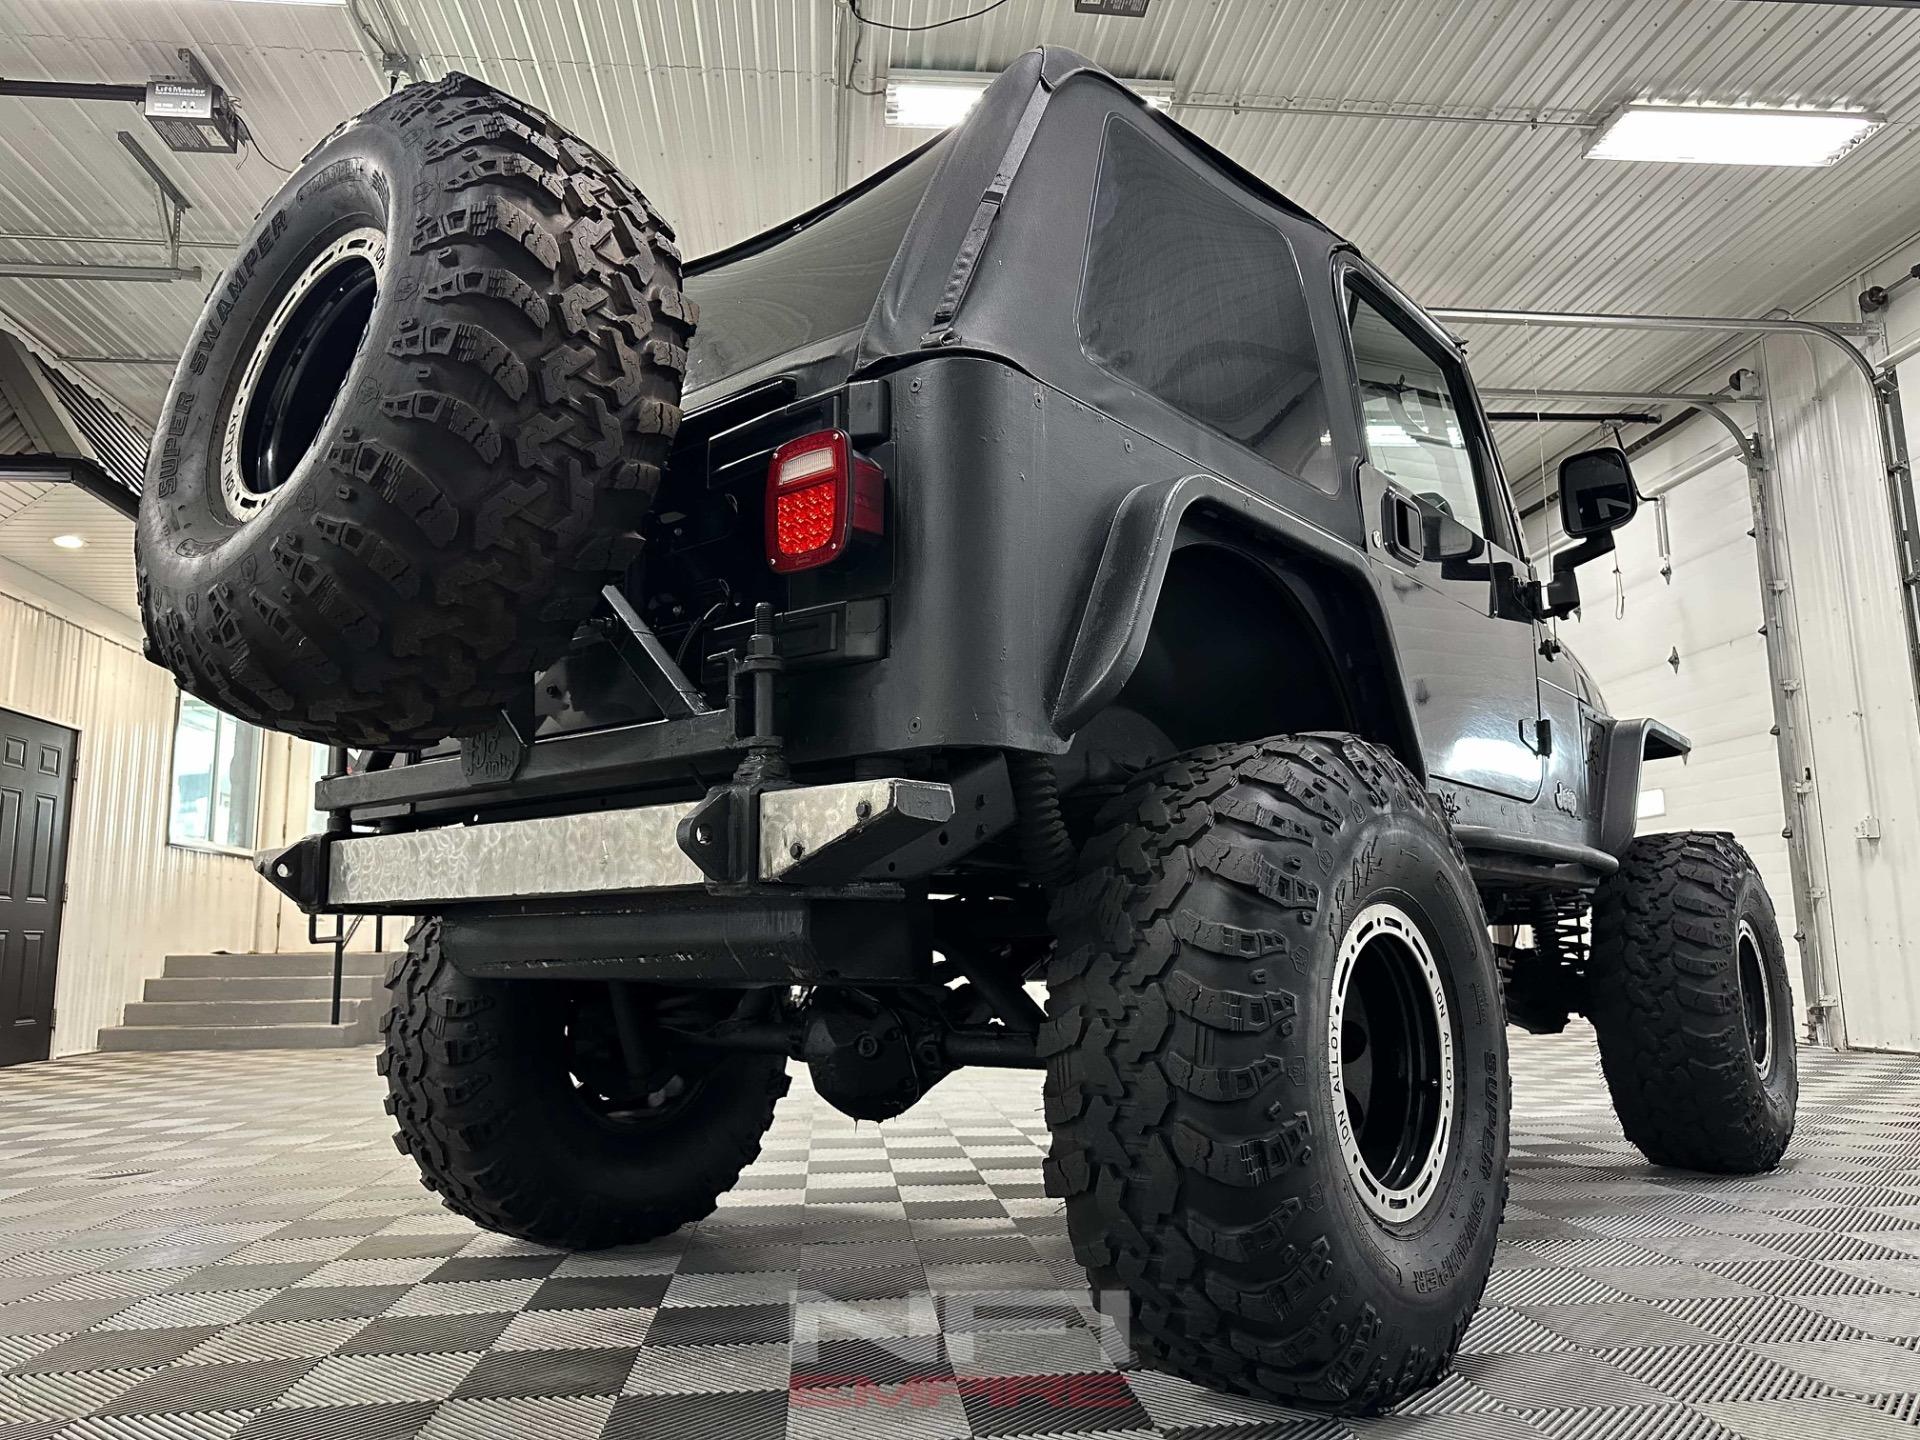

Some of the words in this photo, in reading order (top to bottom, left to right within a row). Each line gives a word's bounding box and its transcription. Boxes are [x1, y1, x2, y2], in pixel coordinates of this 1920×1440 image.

[155, 85, 206, 94] LiftMaster
[159, 391, 195, 498] SUPER
[189, 209, 288, 377] SWAMPER
[224, 413, 239, 464] ALLOY
[224, 469, 235, 496] ION
[1554, 781, 1577, 818] Jeep
[1331, 1024, 1341, 1094] ALLOY
[1434, 985, 1447, 1020] ION
[1442, 1032, 1453, 1095] ALLOY
[1337, 1109, 1351, 1147] ION
[1482, 1049, 1499, 1182] SUPER
[1415, 1190, 1486, 1294] SWAMPER
